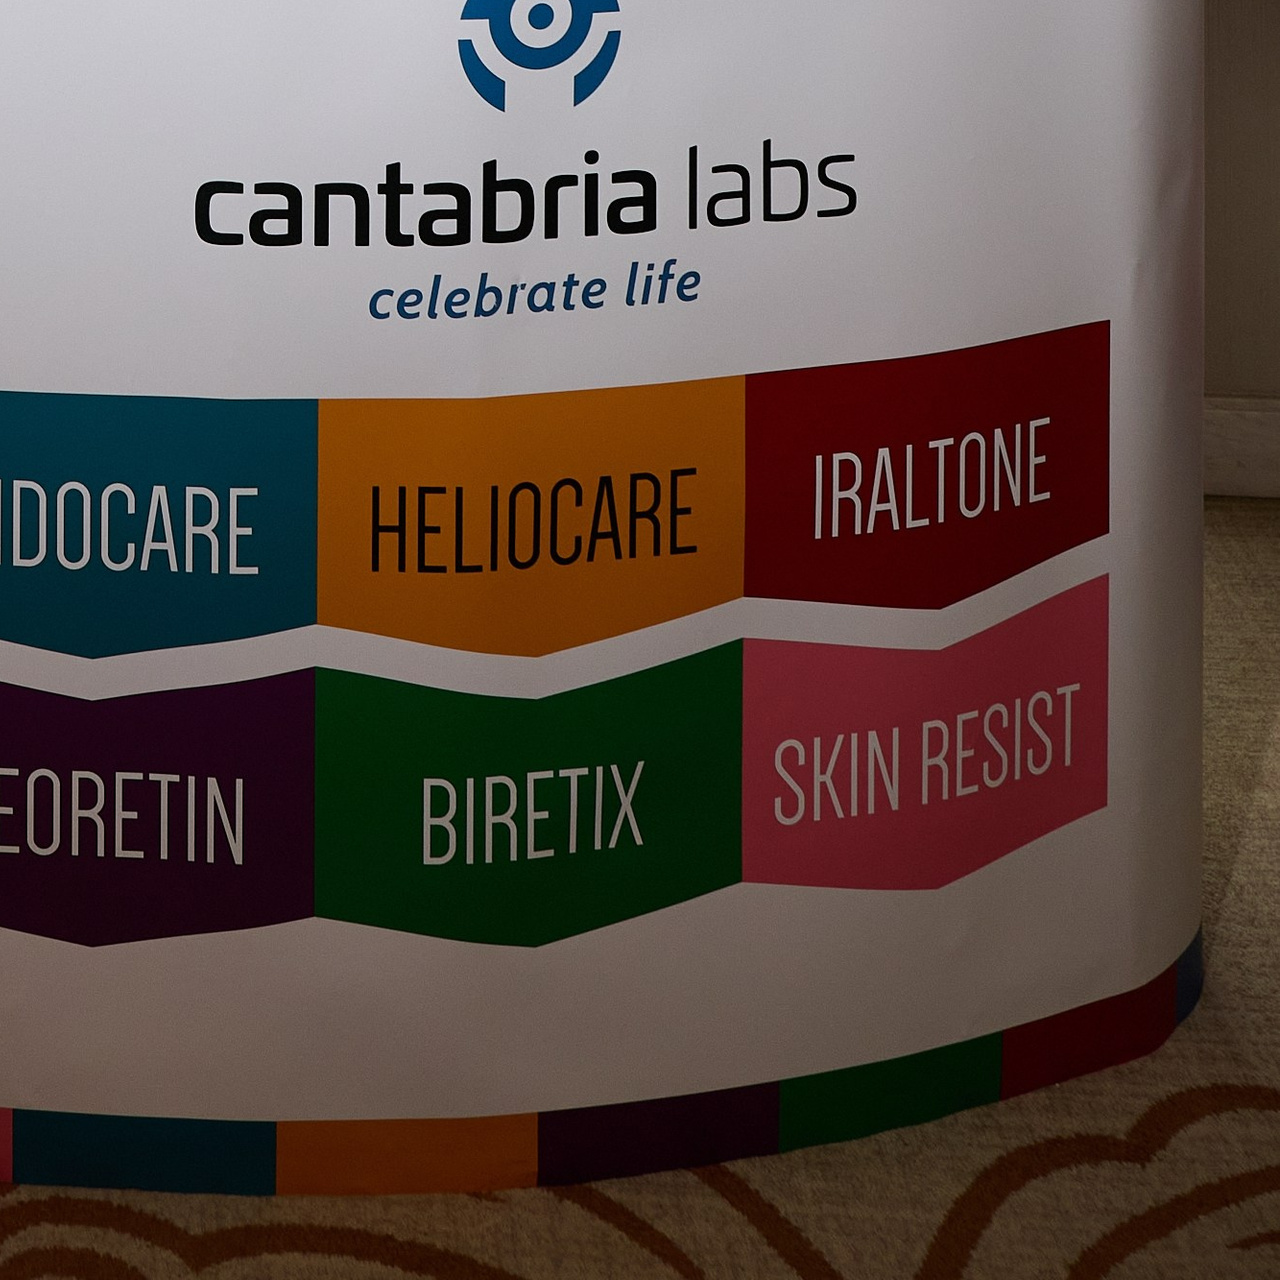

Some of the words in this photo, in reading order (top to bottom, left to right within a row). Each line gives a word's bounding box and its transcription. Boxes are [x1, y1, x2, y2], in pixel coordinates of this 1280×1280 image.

[193, 148, 659, 249] cantabria
[685, 137, 859, 231] labs
[367, 269, 608, 323] celebrate
[623, 258, 703, 310] life
[370, 465, 699, 577] HELIOCARE
[811, 415, 1054, 541] IRALTONE
[771, 725, 902, 829] SKIN
[918, 682, 1082, 808] RESIST
[420, 758, 646, 868] BIRETIX
